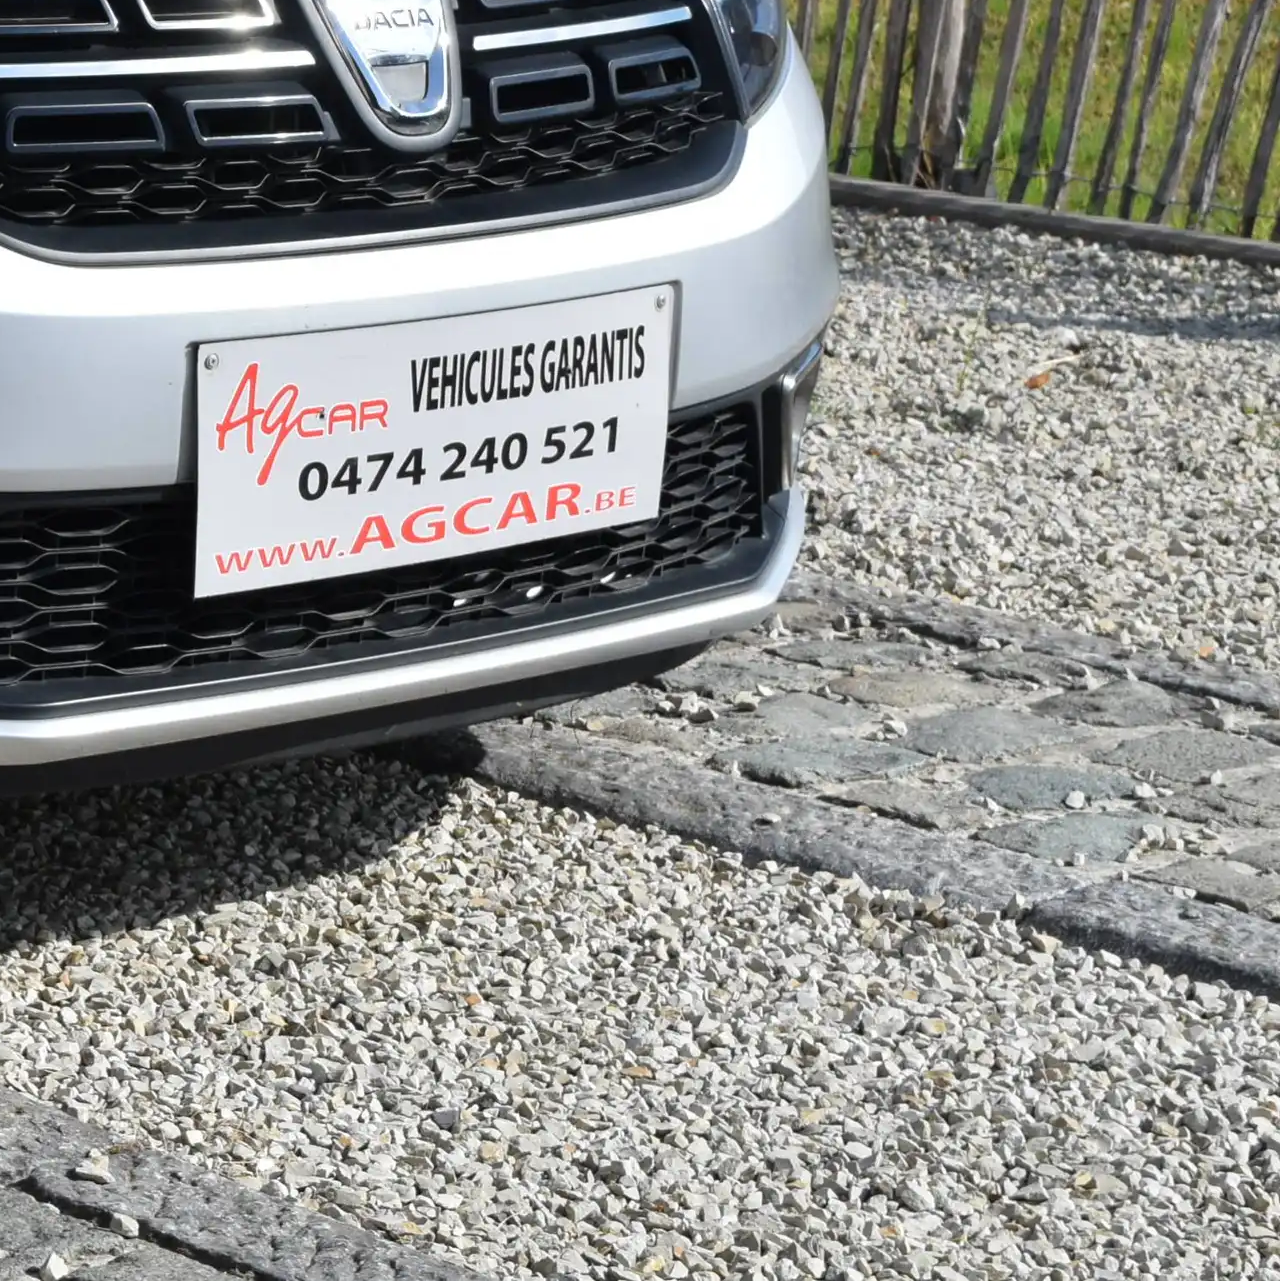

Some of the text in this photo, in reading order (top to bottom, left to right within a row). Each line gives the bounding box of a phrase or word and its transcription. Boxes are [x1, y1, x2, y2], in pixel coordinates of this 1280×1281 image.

[410, 325, 646, 413] VEHICULES GARANTIS
[298, 416, 619, 501] 0474 240 521
